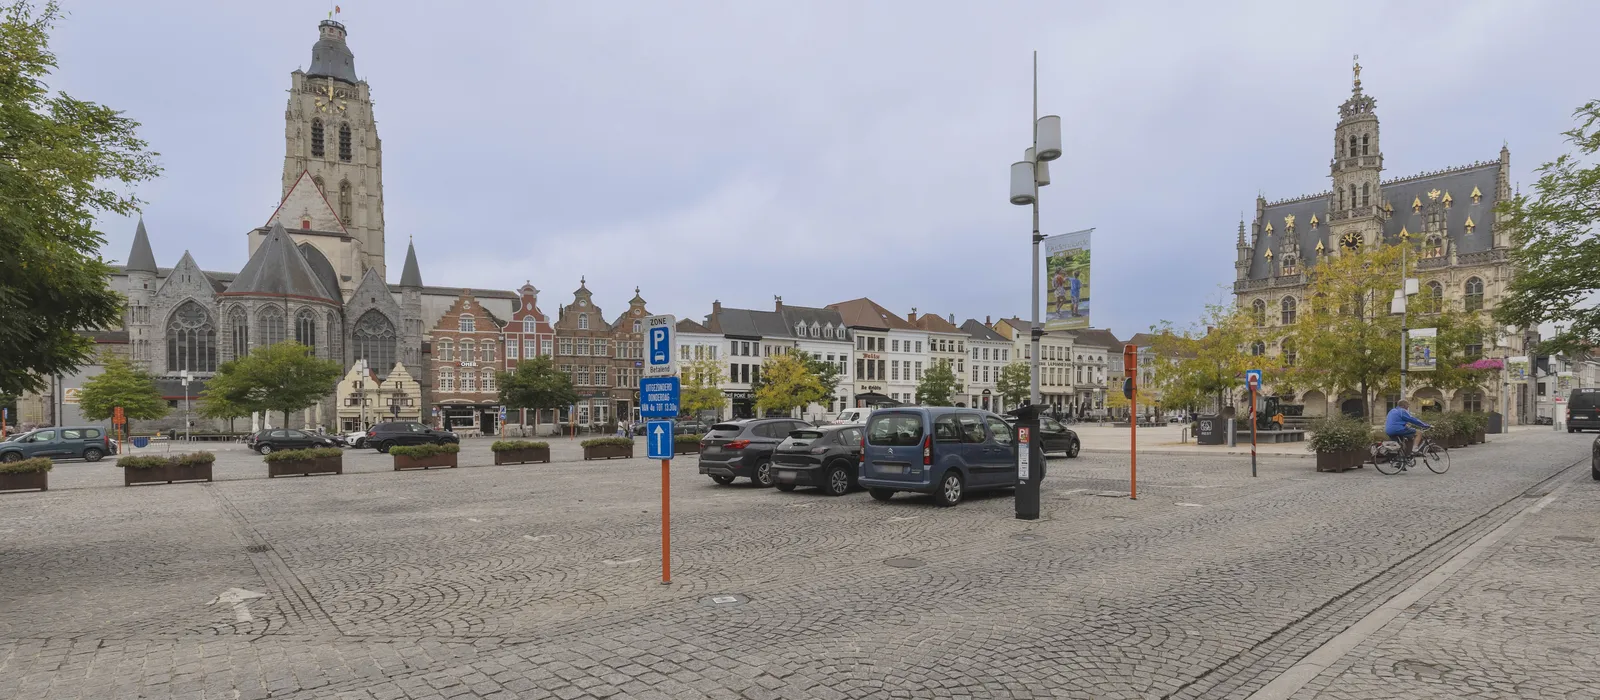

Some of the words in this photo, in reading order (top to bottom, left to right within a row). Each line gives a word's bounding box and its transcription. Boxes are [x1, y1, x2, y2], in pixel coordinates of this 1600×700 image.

[650, 318, 666, 326] ZONE
[653, 330, 665, 350] P
[650, 365, 670, 373] Betalend
[645, 383, 672, 392] UITGEZONDERD
[648, 393, 670, 402] DONDERDAG
[641, 403, 649, 411] VAN
